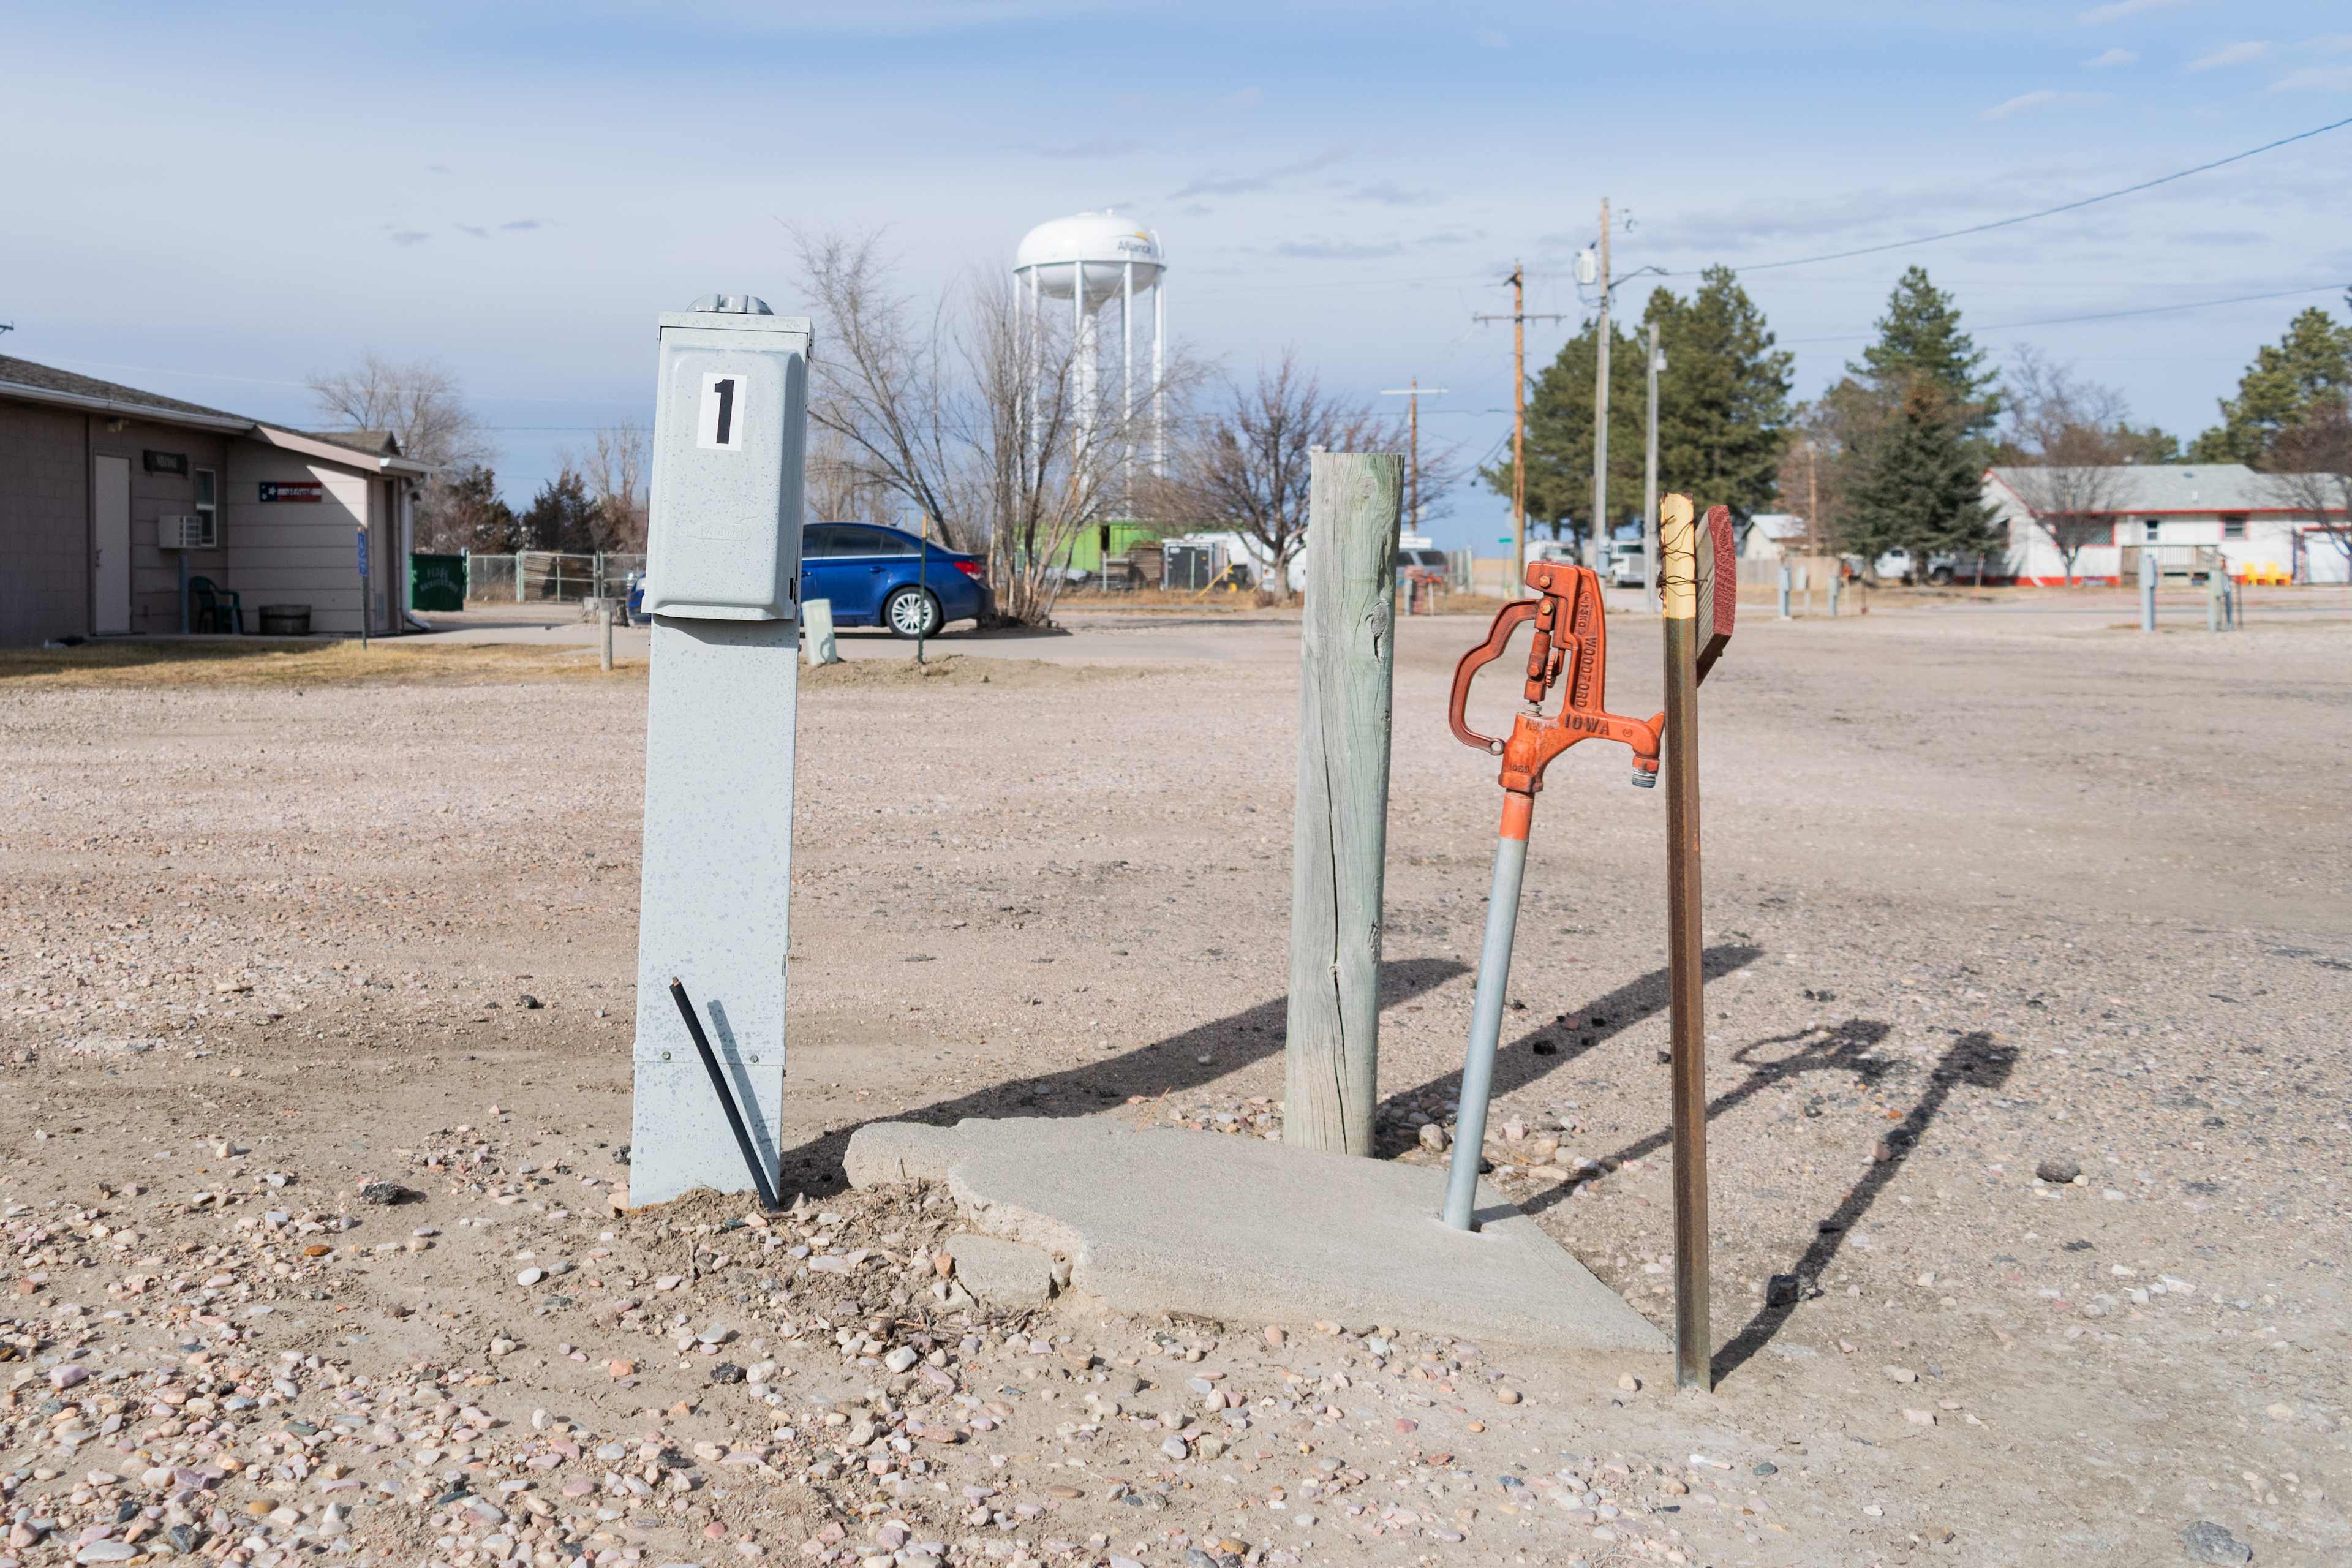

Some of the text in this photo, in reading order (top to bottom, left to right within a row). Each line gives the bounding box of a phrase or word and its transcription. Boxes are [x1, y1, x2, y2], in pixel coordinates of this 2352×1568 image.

[714, 379, 735, 444] 1
[1575, 636, 1597, 708] WOODFORD
[1564, 712, 1610, 736] IOWA
